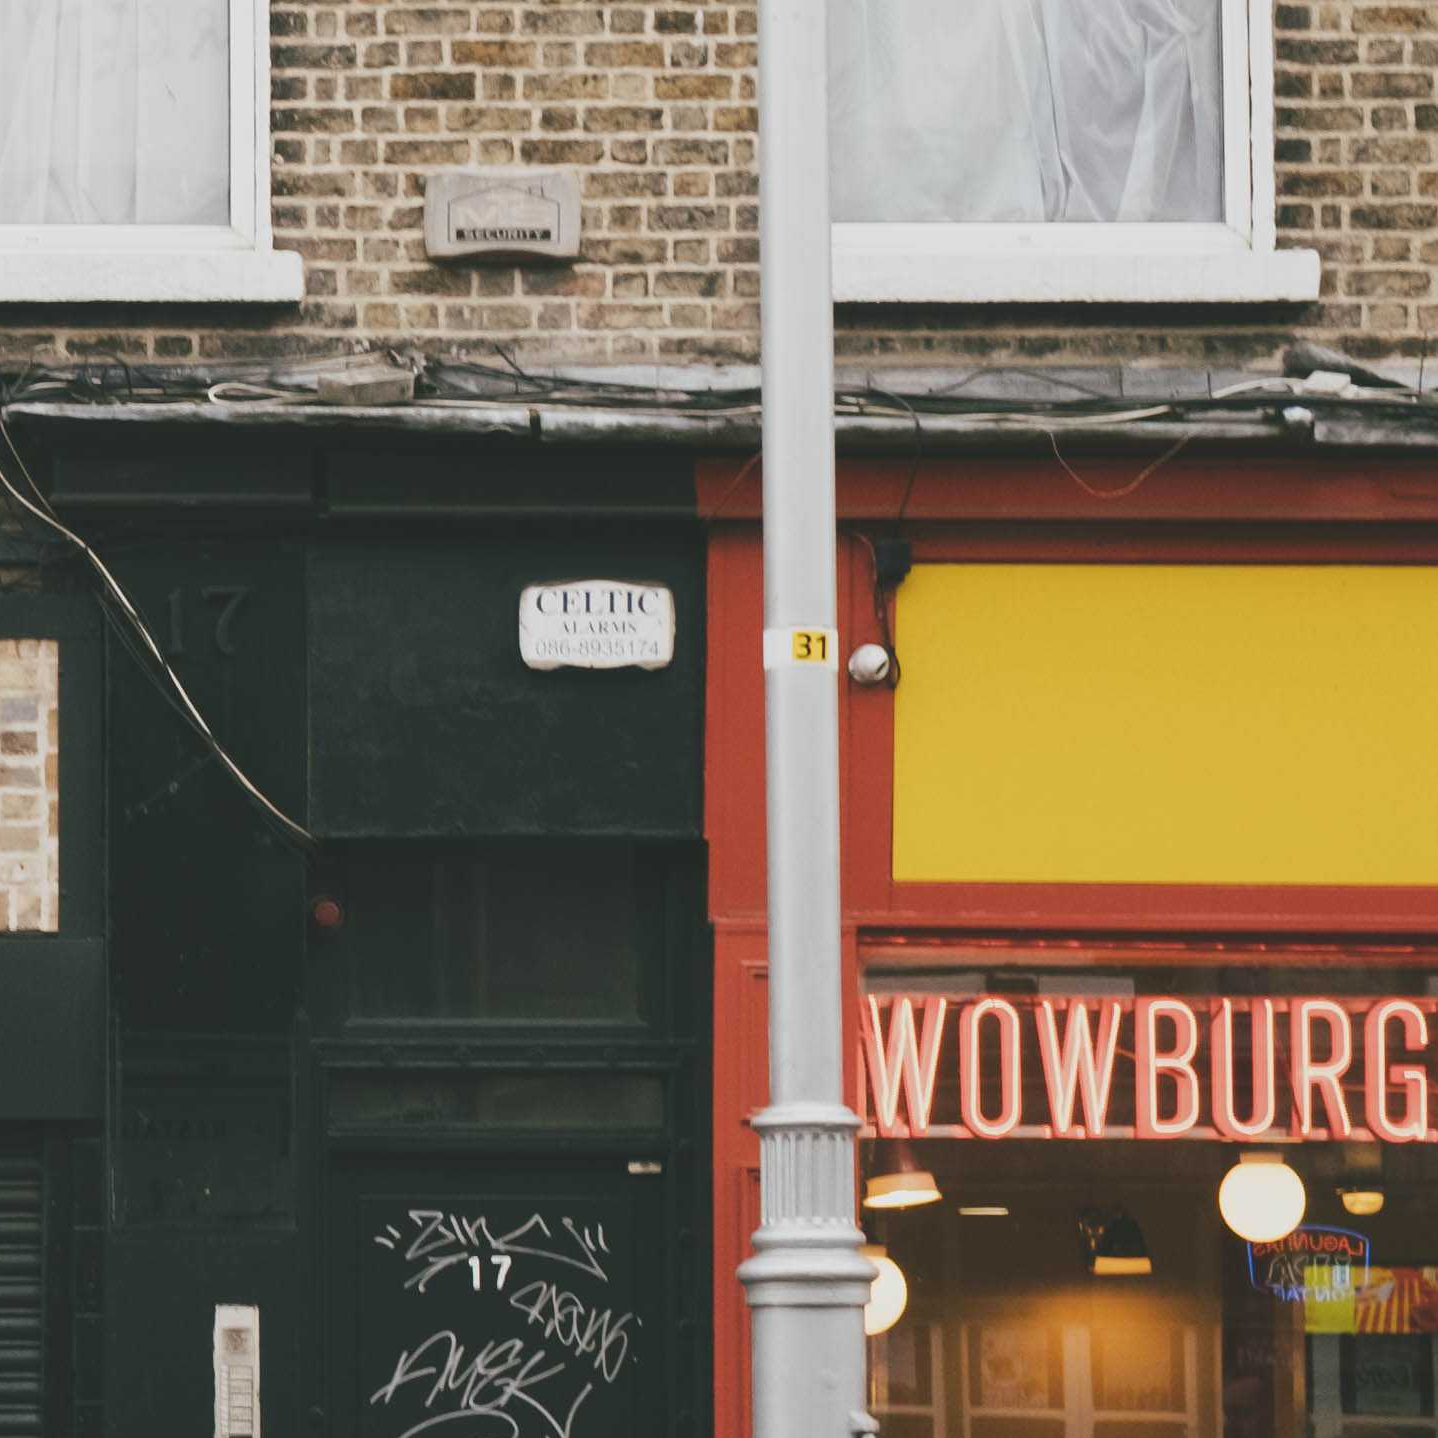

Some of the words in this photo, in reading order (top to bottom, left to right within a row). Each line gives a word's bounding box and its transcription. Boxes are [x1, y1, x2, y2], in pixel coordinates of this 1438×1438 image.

[536, 589, 660, 615] CELTIC
[562, 620, 637, 634] ALARMS
[795, 633, 827, 661] 31
[468, 1255, 512, 1290] 17
